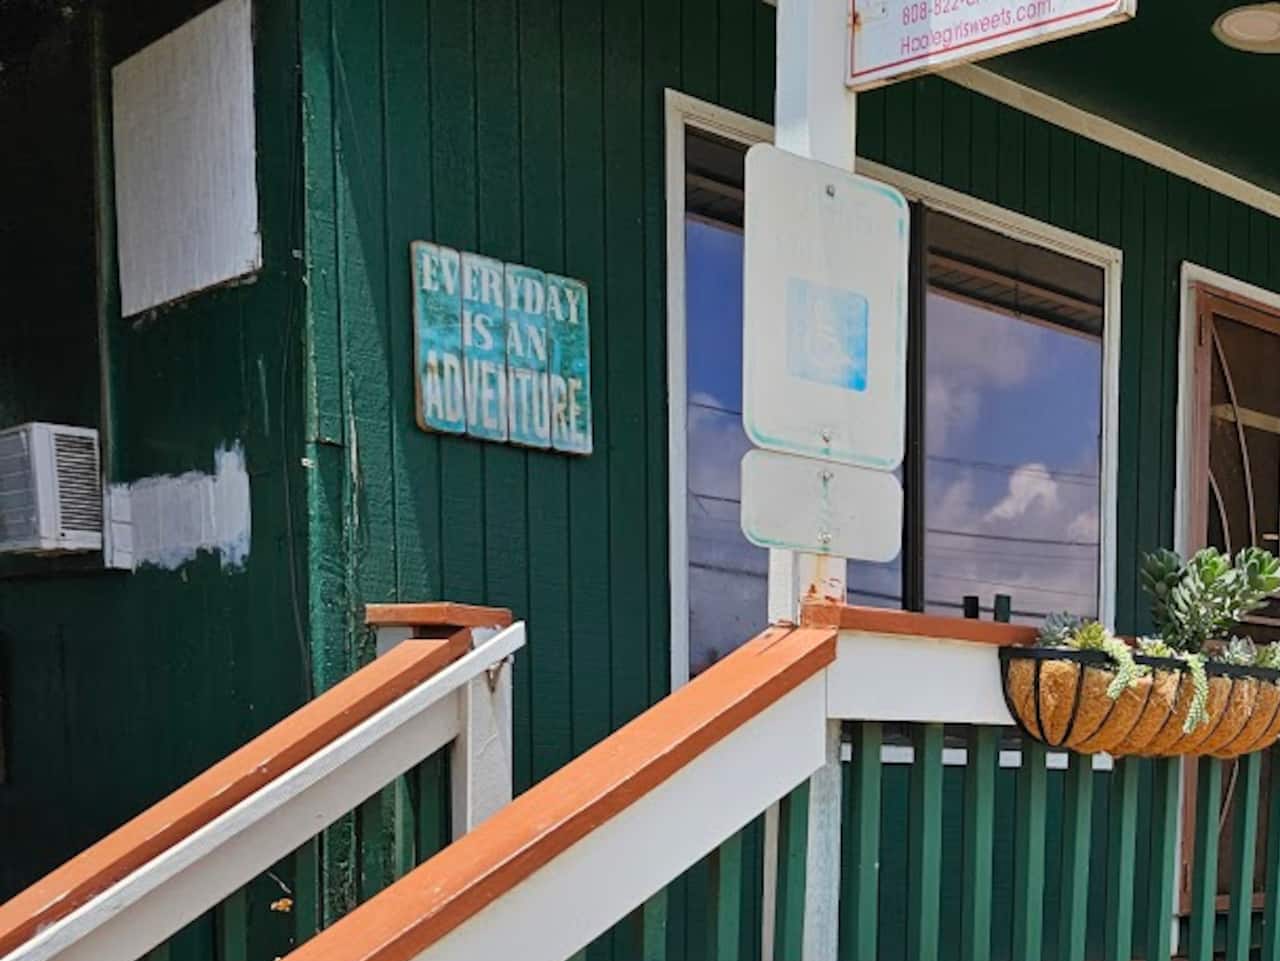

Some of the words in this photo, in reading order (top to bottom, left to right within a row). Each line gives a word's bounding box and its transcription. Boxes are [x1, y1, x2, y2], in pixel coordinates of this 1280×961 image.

[420, 251, 580, 325] EVERYDAY
[462, 311, 494, 351] IS
[506, 319, 547, 361] AN
[424, 349, 587, 444] ADVENTURE
